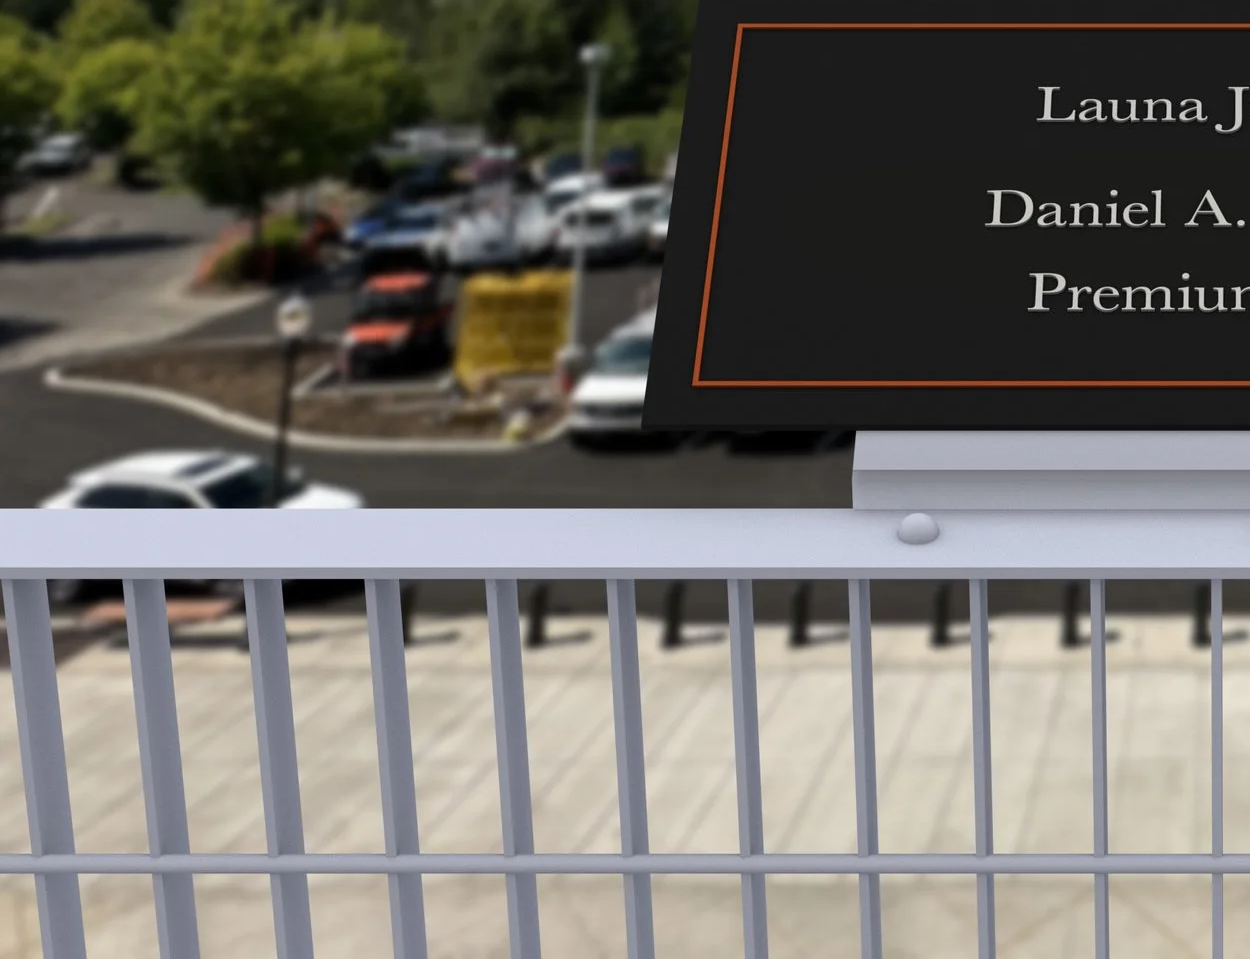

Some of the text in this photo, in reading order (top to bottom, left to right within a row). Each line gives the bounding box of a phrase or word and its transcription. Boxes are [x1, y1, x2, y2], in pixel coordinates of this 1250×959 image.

[1036, 86, 1208, 122] Launa
[984, 189, 1167, 227] Daniel
[1184, 189, 1246, 227] A.
